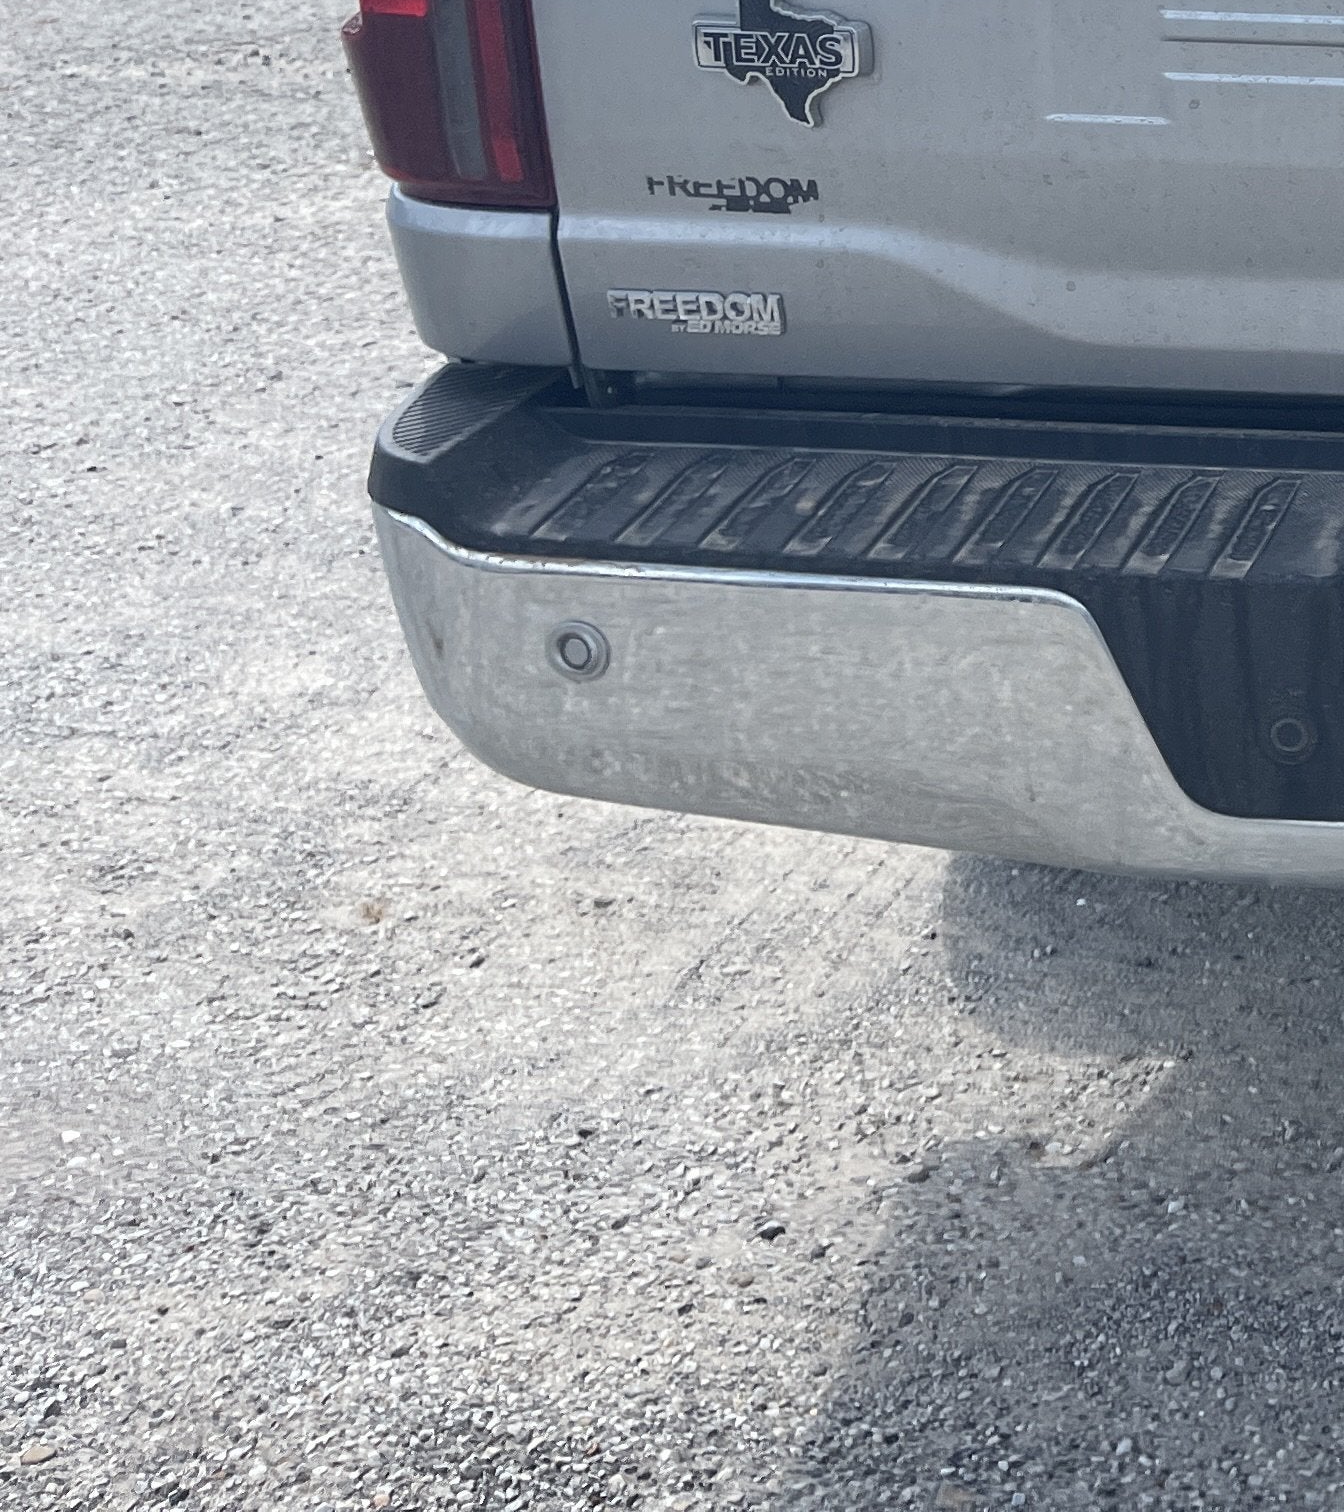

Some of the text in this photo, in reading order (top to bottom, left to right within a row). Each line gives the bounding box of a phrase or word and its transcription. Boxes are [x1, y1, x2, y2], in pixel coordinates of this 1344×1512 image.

[702, 30, 844, 70] TEXAS
[766, 66, 829, 79] EDITION
[606, 289, 783, 323] FREEDOM
[672, 319, 782, 336] BY ED MORSE
